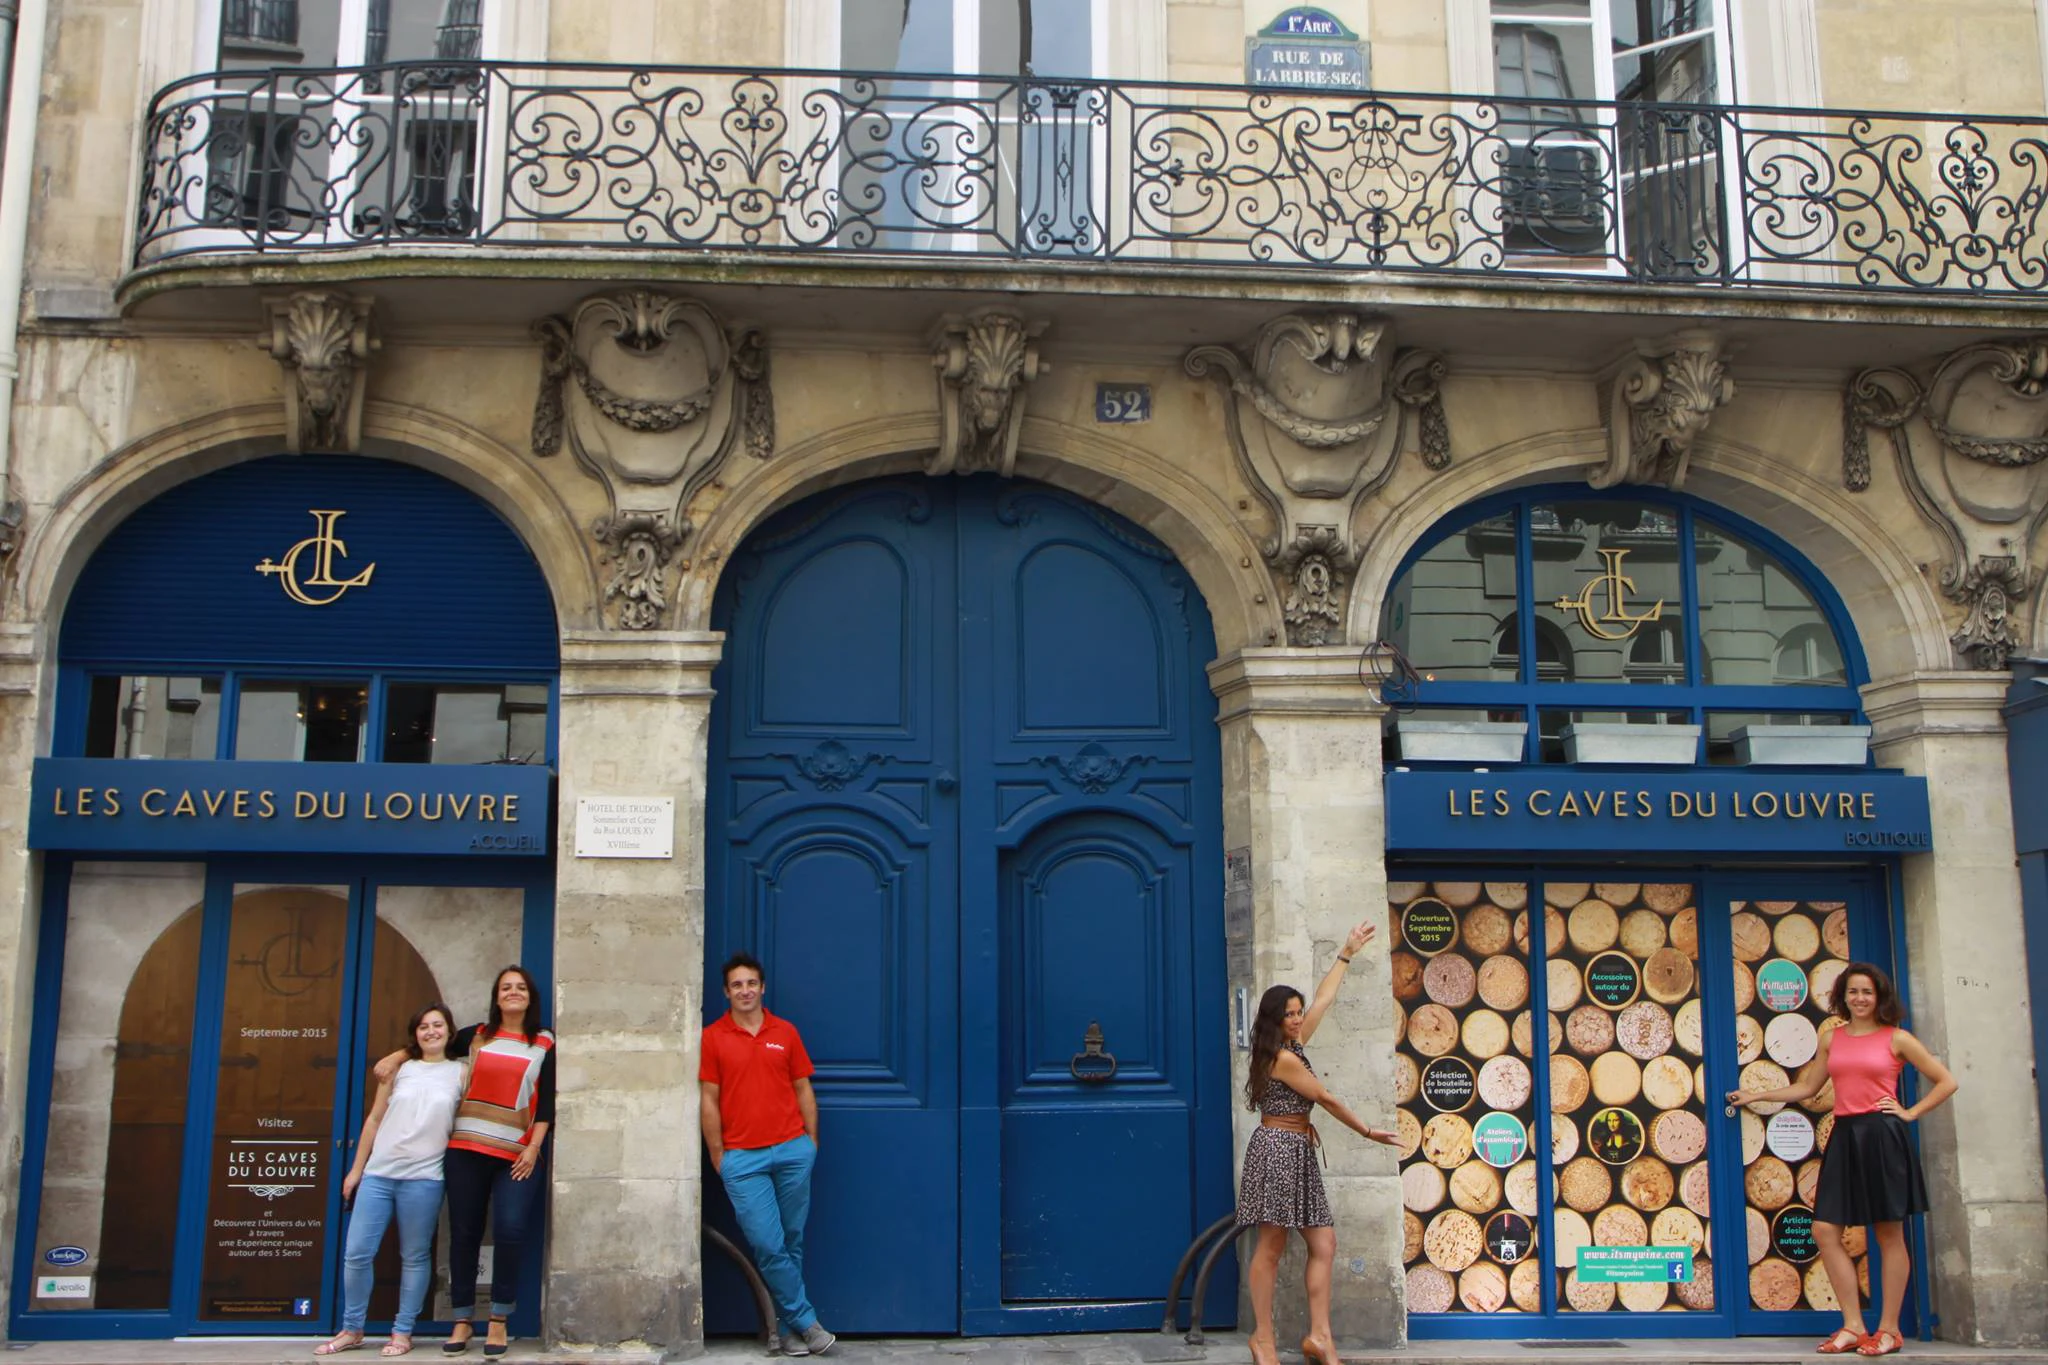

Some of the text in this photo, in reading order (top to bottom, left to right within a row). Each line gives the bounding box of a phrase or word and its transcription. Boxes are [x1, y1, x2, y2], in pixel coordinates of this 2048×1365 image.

[1272, 50, 1344, 66] RUE DE
[1255, 69, 1361, 86] L'ARBRE-SEC
[1105, 390, 1141, 419] 52
[54, 787, 519, 822] LES CAVES DU LOUVRE
[616, 804, 627, 813] DE
[1449, 789, 1876, 819] LES CAVES DU LOUVRE
[469, 834, 540, 850] ACCUEIL
[1845, 831, 1928, 847] BOUTIQUE
[1409, 914, 1450, 922] Ouverture
[1408, 924, 1451, 933] Septembre
[1591, 973, 1633, 981] Accessoires
[1619, 983, 1630, 991] du
[240, 1027, 328, 1039] Septembre 2015
[1430, 1071, 1468, 1079] Sélection
[1434, 1088, 1471, 1096] emporter
[257, 1118, 294, 1128] Visitez
[229, 1152, 317, 1163] LES CAVES
[228, 1166, 316, 1177] DU LOUVRE
[213, 1219, 256, 1227] Découvrez
[295, 1219, 306, 1227] du
[1782, 1216, 1812, 1224] Articles
[1785, 1226, 1812, 1236] design
[284, 1240, 313, 1248] unique
[258, 1249, 273, 1257] des
[282, 1249, 302, 1257] Sens
[1584, 1248, 1684, 1262] www.itsmywine.com
